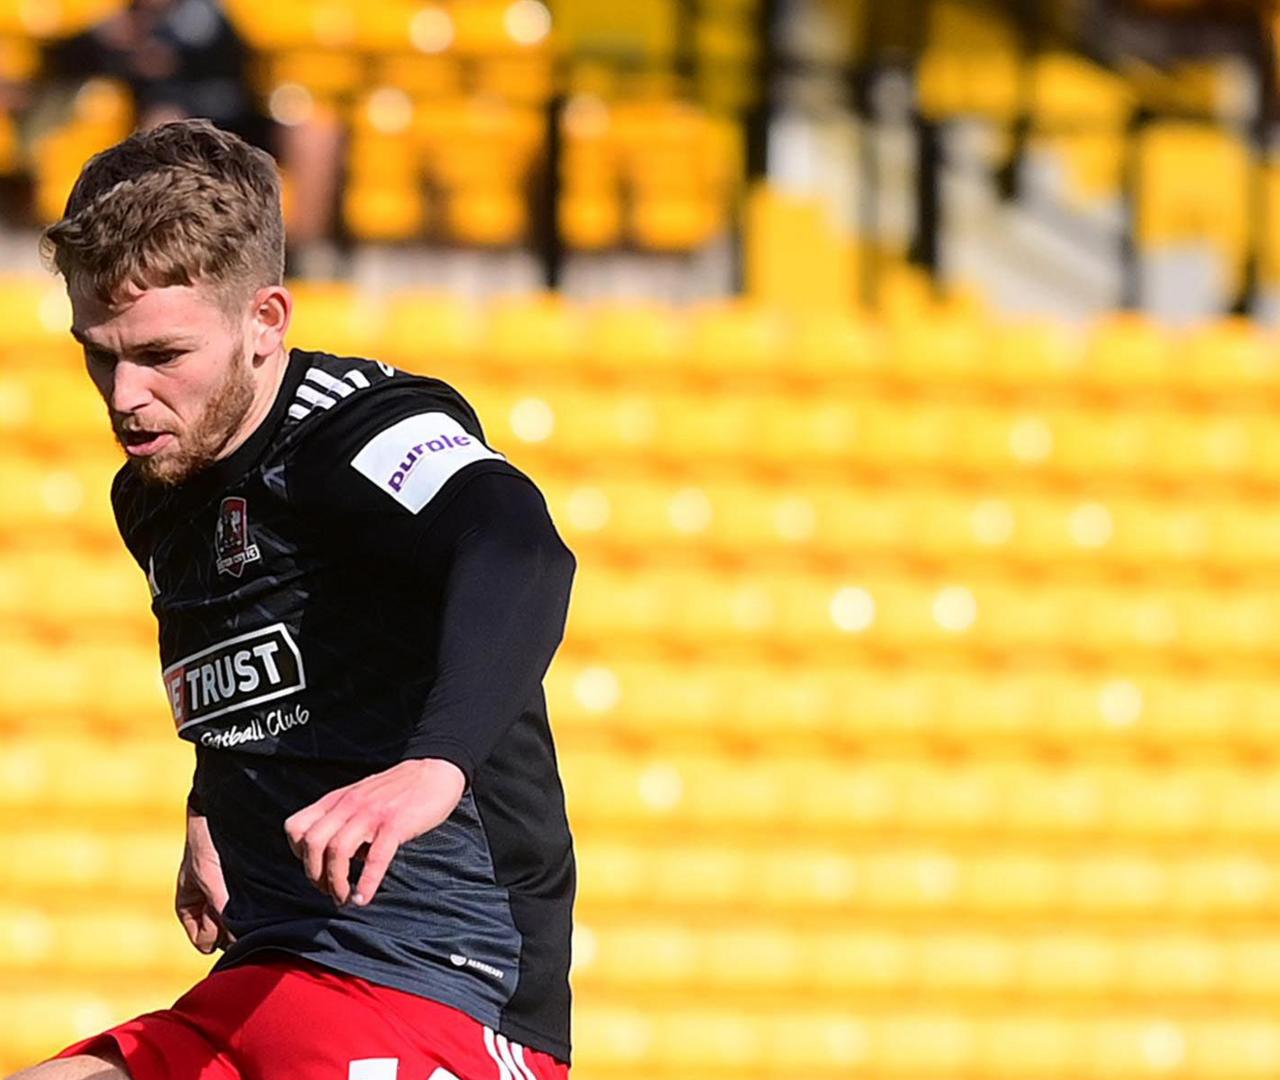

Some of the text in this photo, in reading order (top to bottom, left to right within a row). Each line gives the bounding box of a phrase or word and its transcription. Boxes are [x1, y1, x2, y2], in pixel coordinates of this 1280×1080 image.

[387, 434, 471, 493] purple
[186, 640, 281, 711] TRUST
[266, 703, 310, 736] Club
